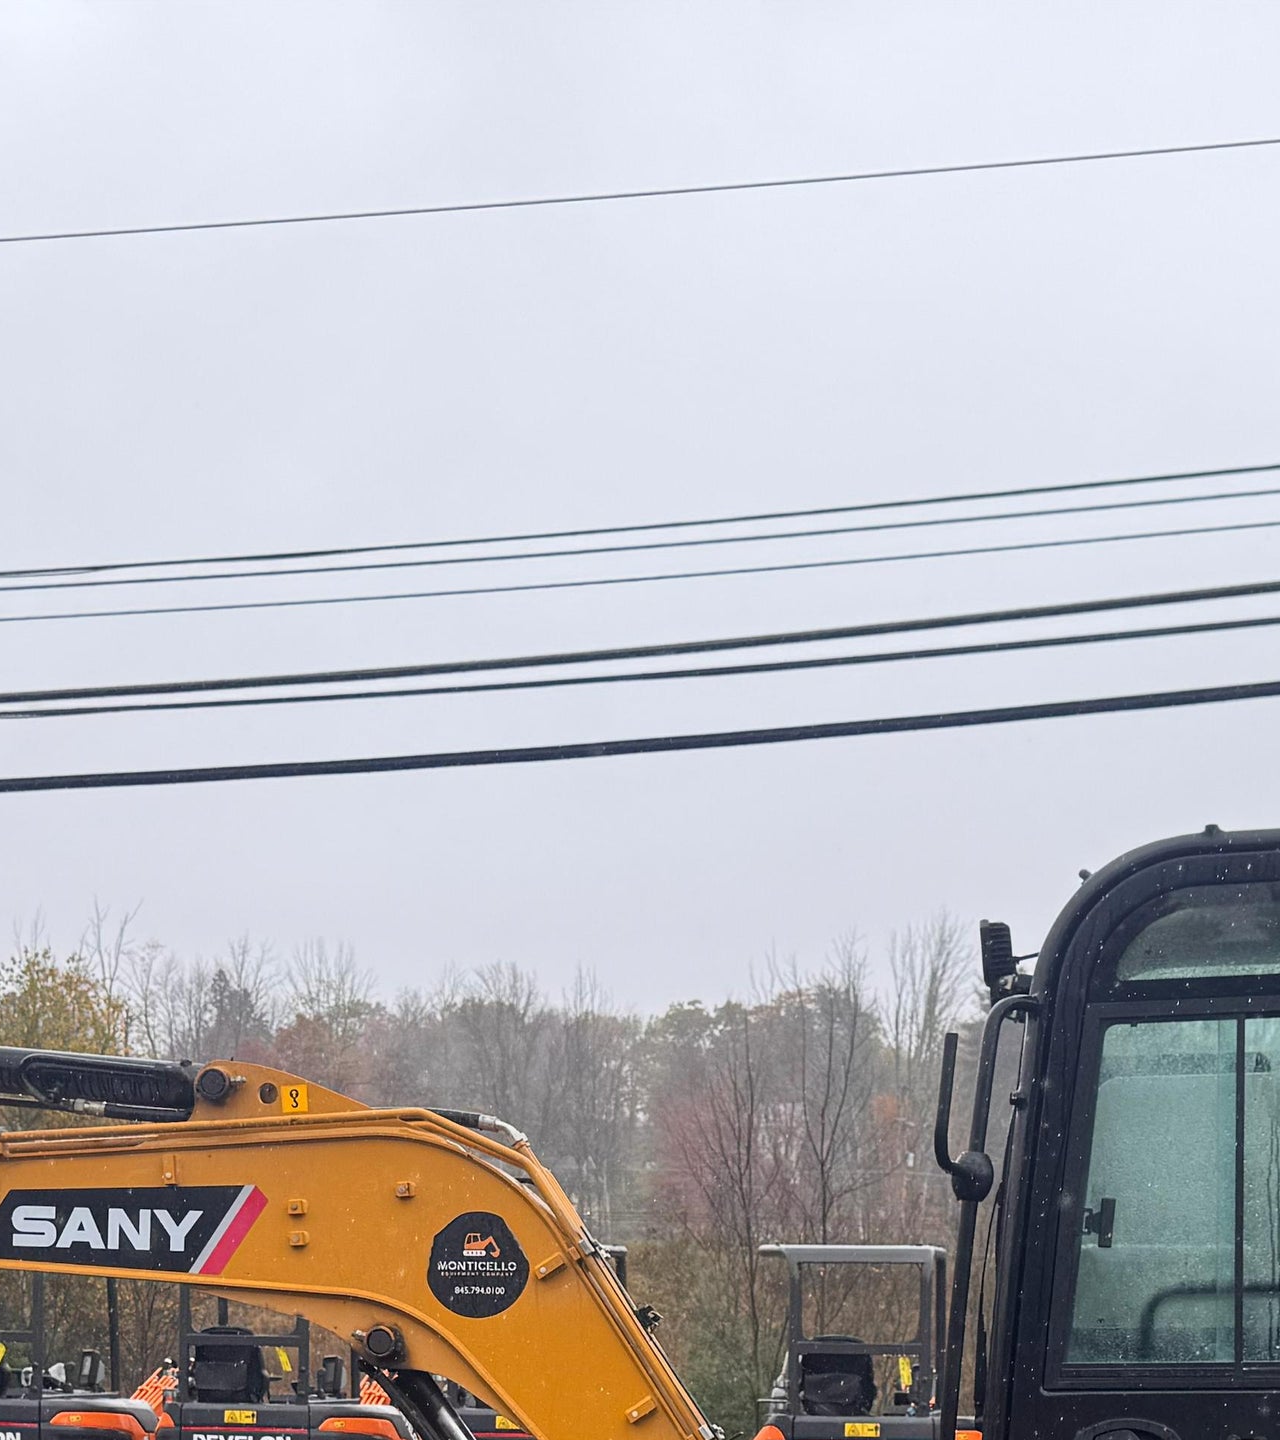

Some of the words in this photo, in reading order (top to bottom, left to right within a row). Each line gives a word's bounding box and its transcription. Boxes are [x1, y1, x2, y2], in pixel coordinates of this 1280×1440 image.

[11, 1205, 204, 1252] SANY
[437, 1260, 518, 1271] MONTICELLO
[454, 1286, 506, 1295] 845.794.0100
